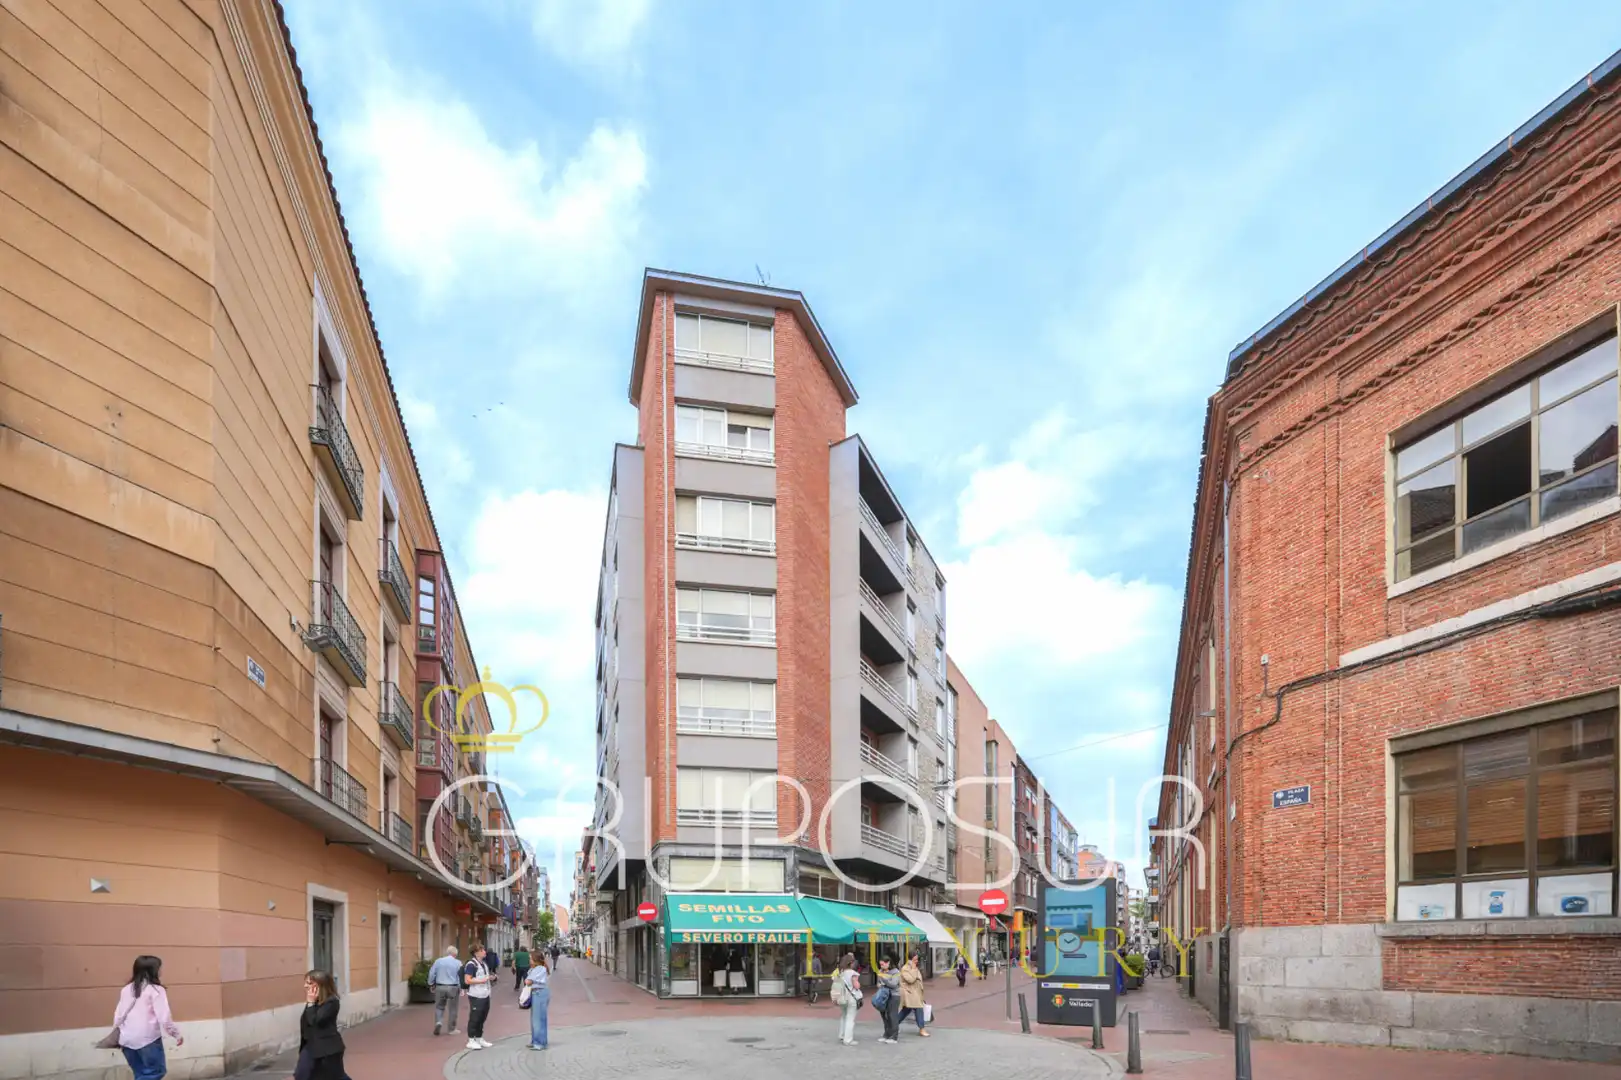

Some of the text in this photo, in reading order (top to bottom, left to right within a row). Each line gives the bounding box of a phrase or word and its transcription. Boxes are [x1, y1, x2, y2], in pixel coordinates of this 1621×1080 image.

[678, 903, 791, 914] SEMILLAS
[711, 914, 765, 924] FITO
[682, 932, 801, 944] SEVERO FRAILE
